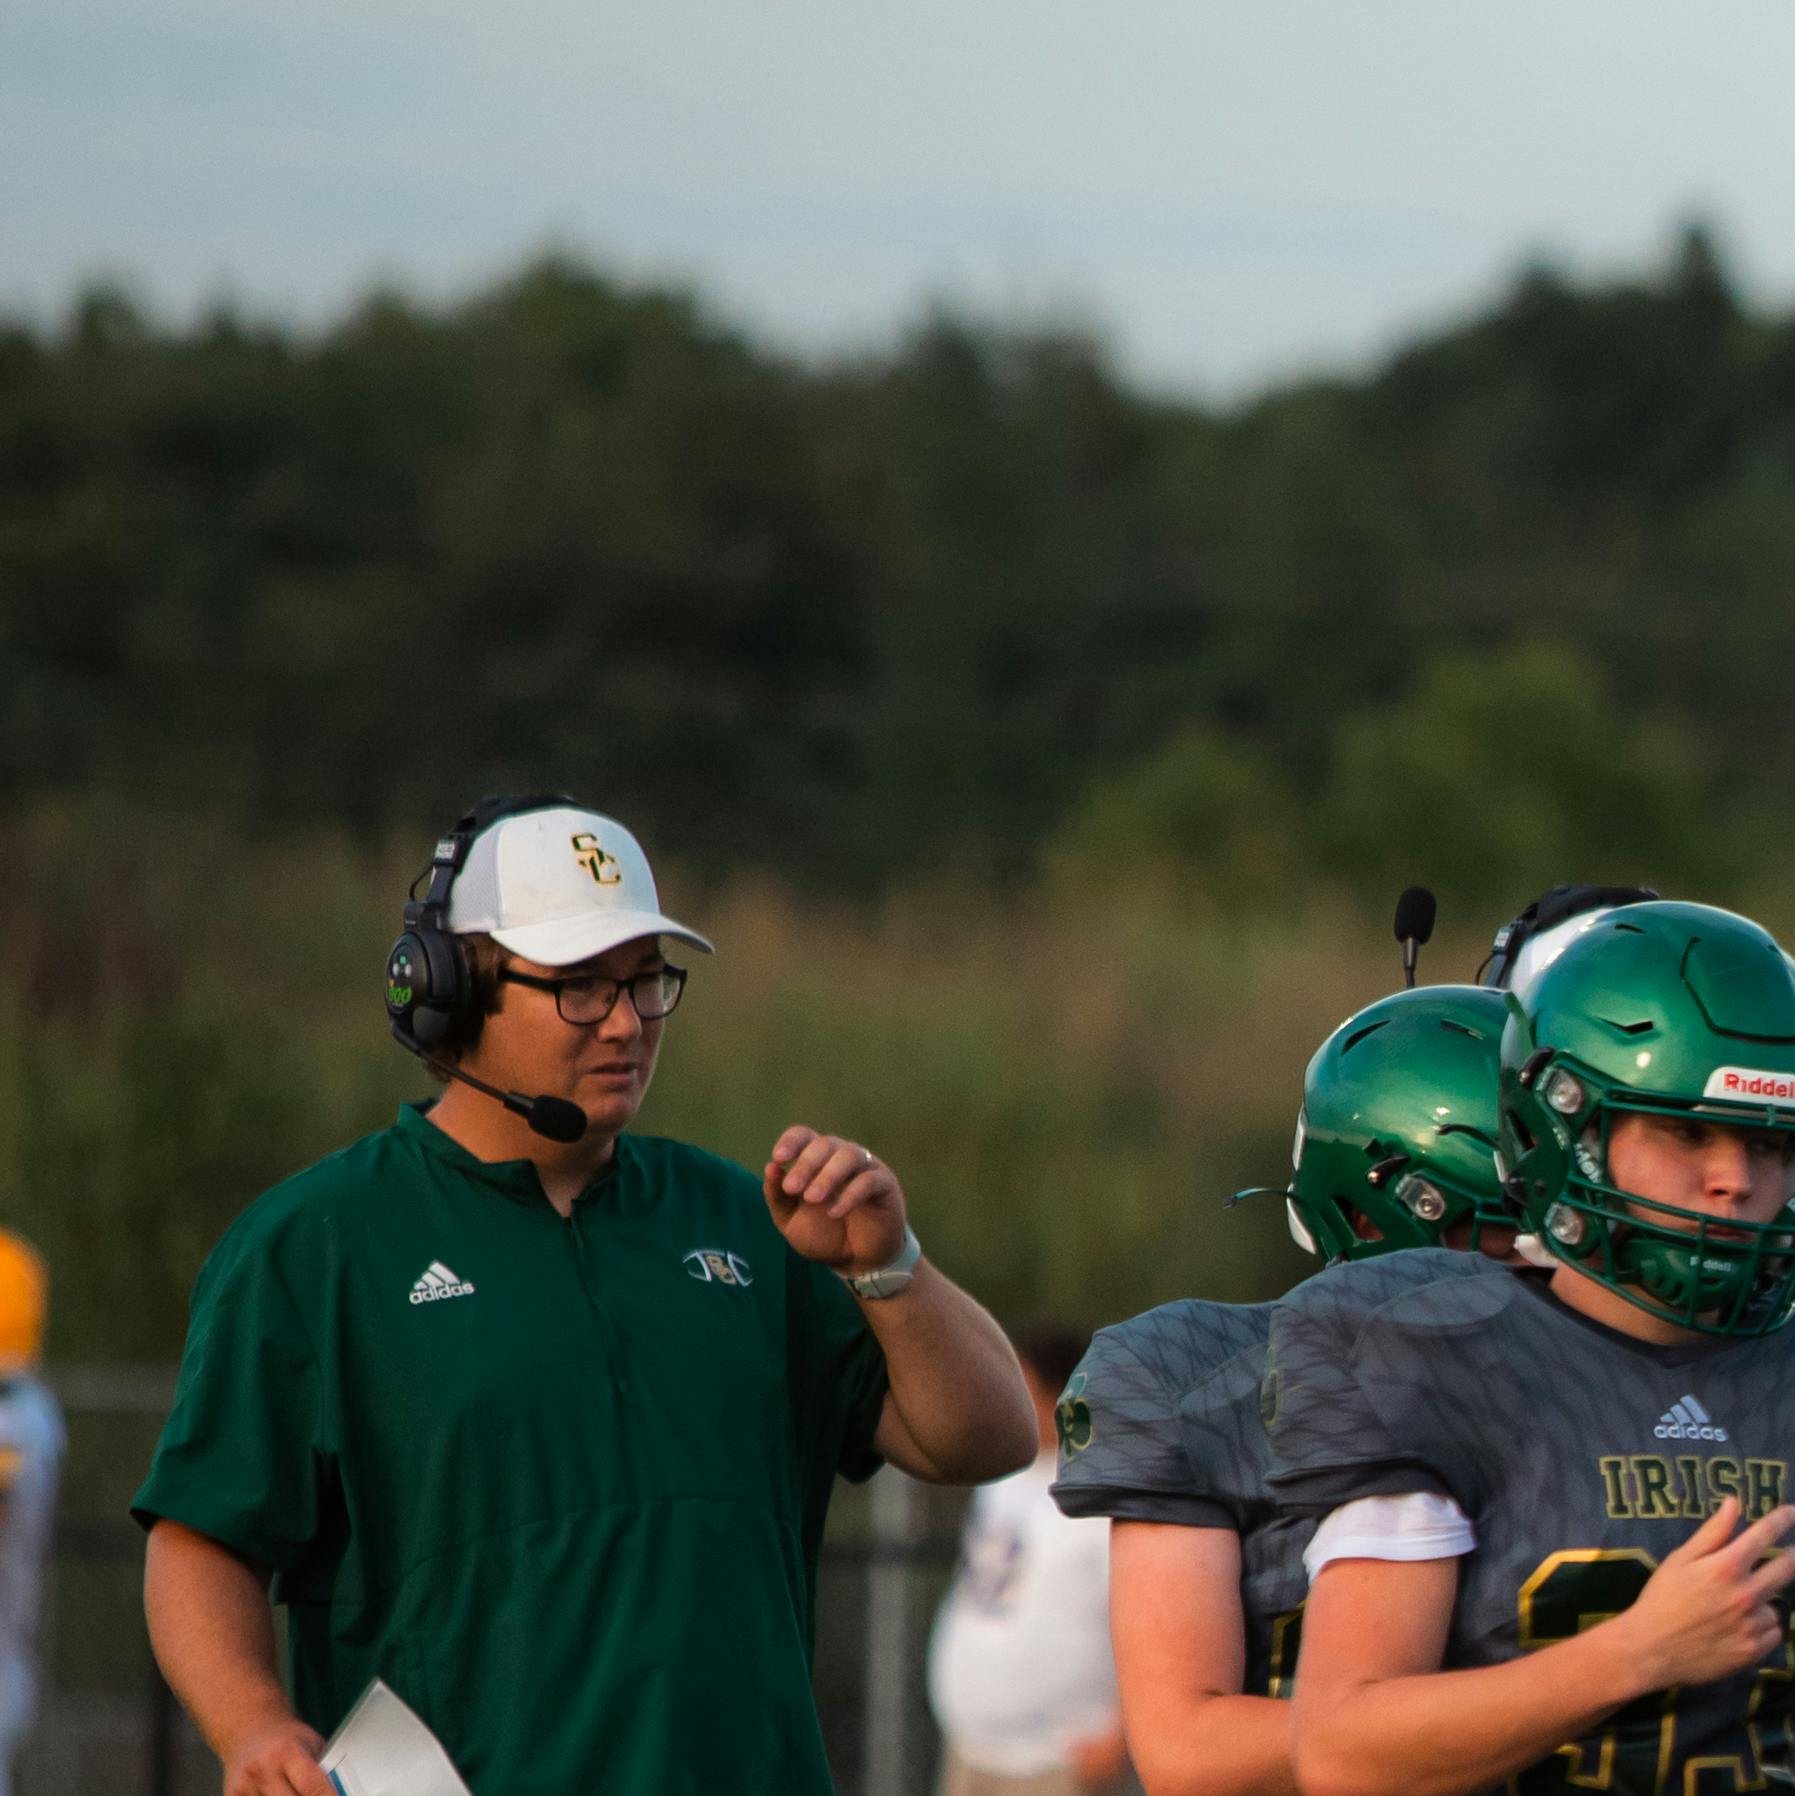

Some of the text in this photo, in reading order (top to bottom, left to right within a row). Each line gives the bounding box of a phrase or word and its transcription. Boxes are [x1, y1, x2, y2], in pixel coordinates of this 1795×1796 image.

[408, 1282, 475, 1305] adidas
[1653, 1422, 1728, 1442] adidas
[1599, 1454, 1788, 1521] IRISH
